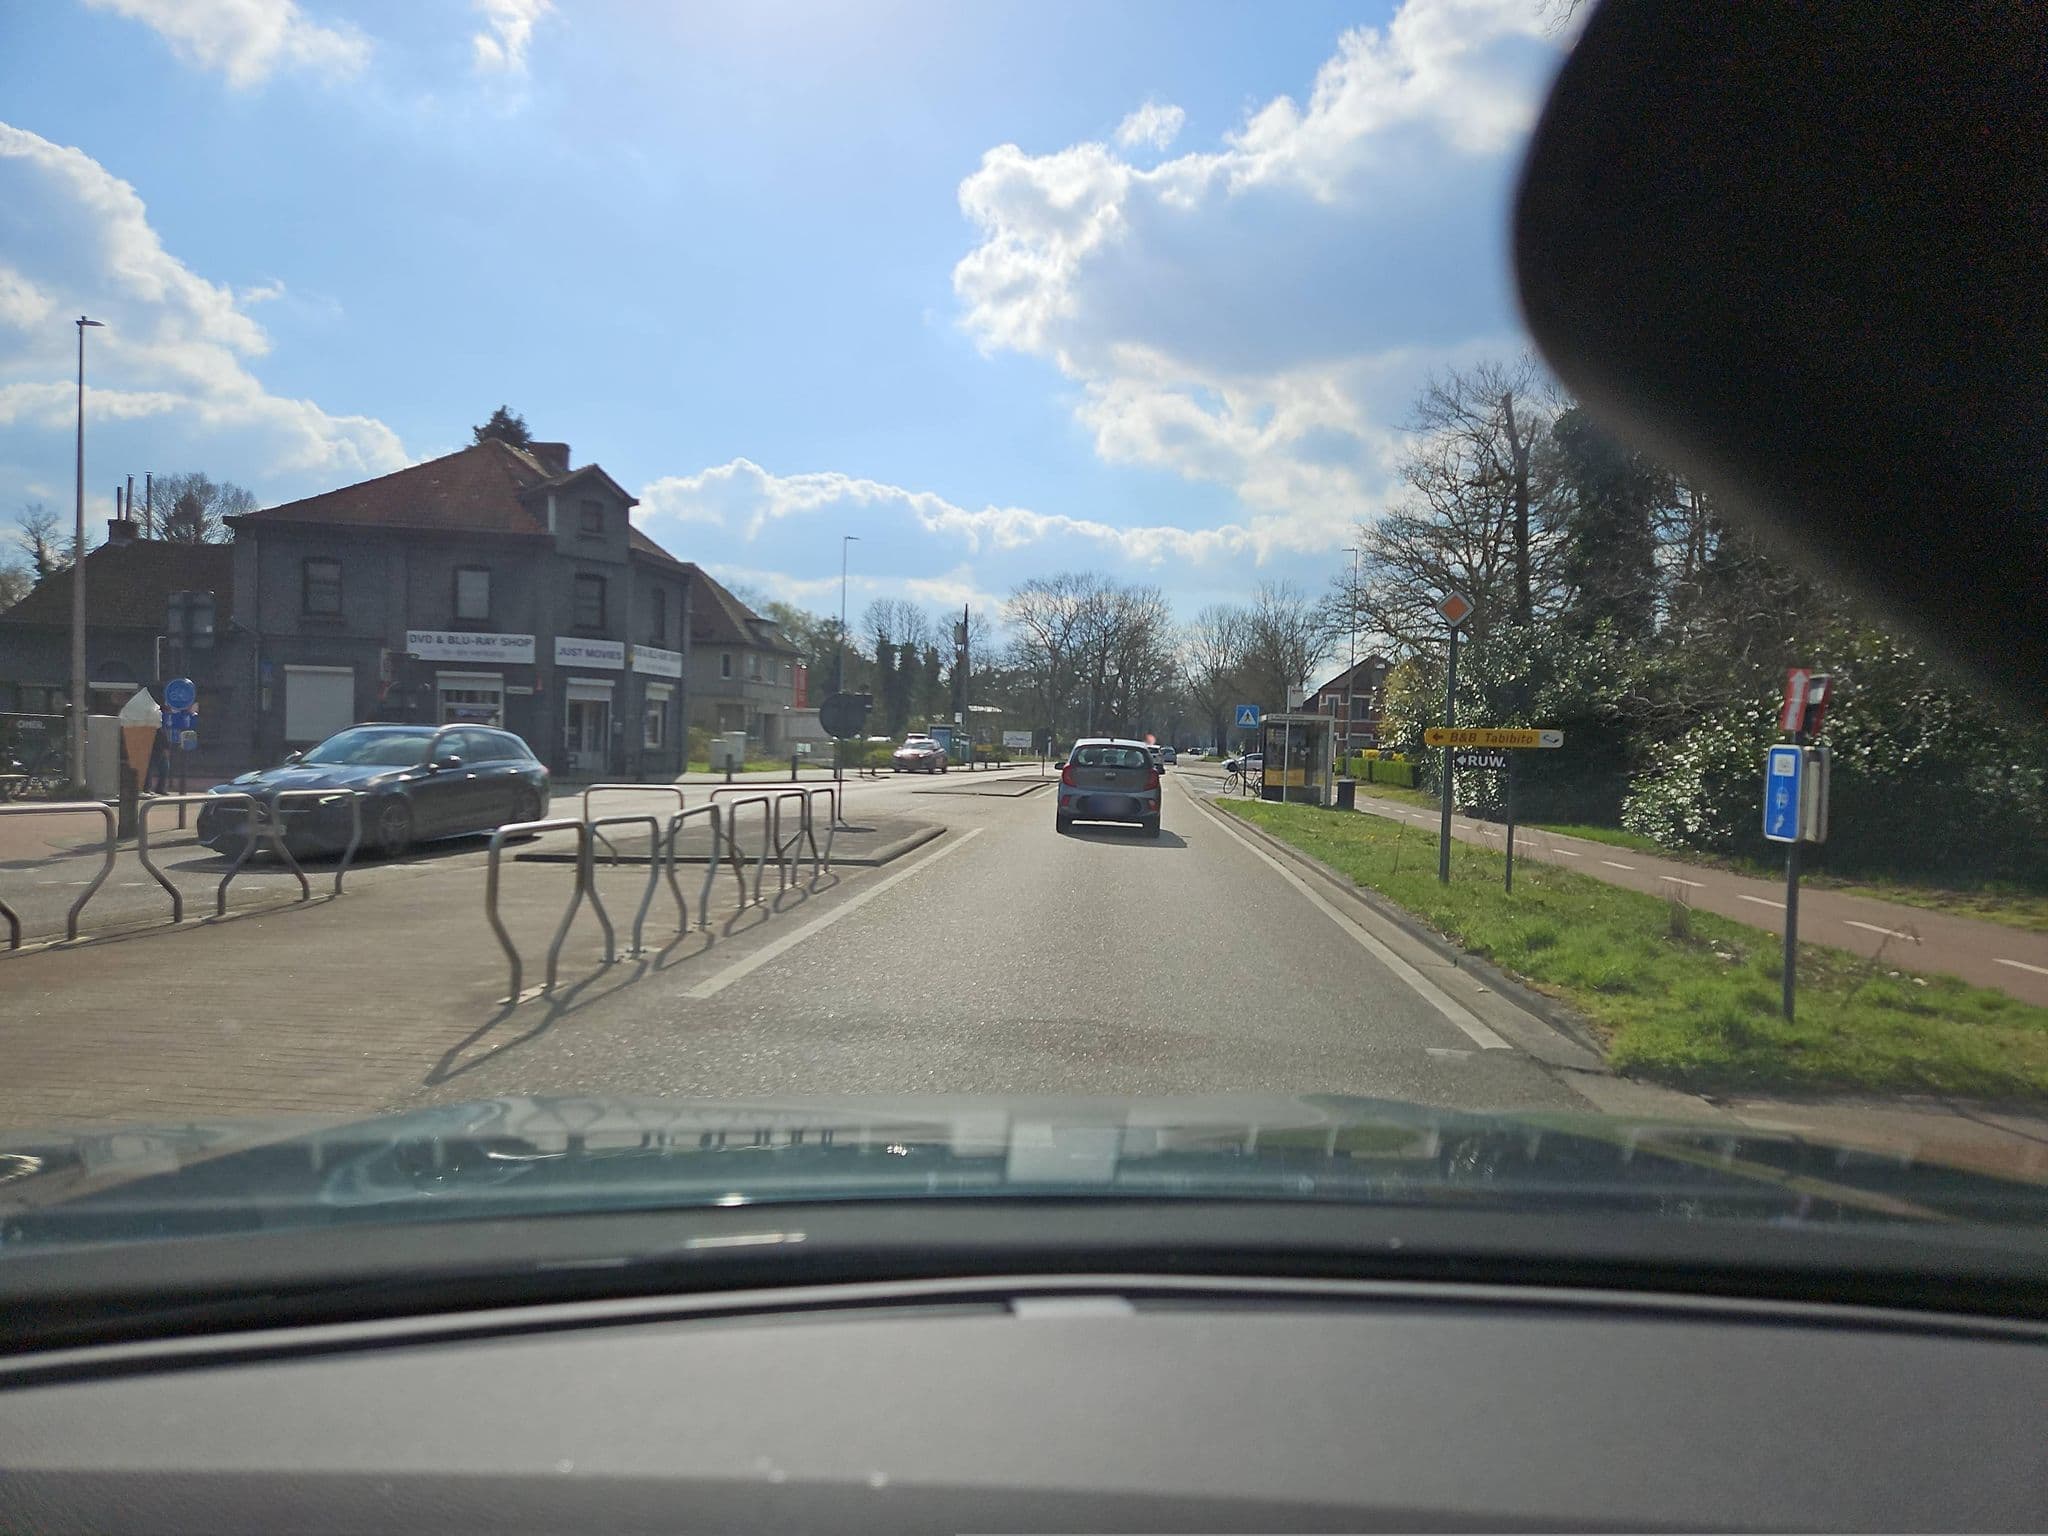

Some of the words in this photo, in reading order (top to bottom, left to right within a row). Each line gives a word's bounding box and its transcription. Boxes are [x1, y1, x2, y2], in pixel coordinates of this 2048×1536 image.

[409, 634, 432, 644] DVD
[436, 635, 444, 644] &
[447, 635, 497, 646] BLU-RAY
[500, 637, 532, 647] SHOP
[559, 647, 583, 657] JUST
[585, 648, 621, 660] MOVIES
[1450, 733, 1477, 743] B&B
[1485, 733, 1533, 744] Tabibito
